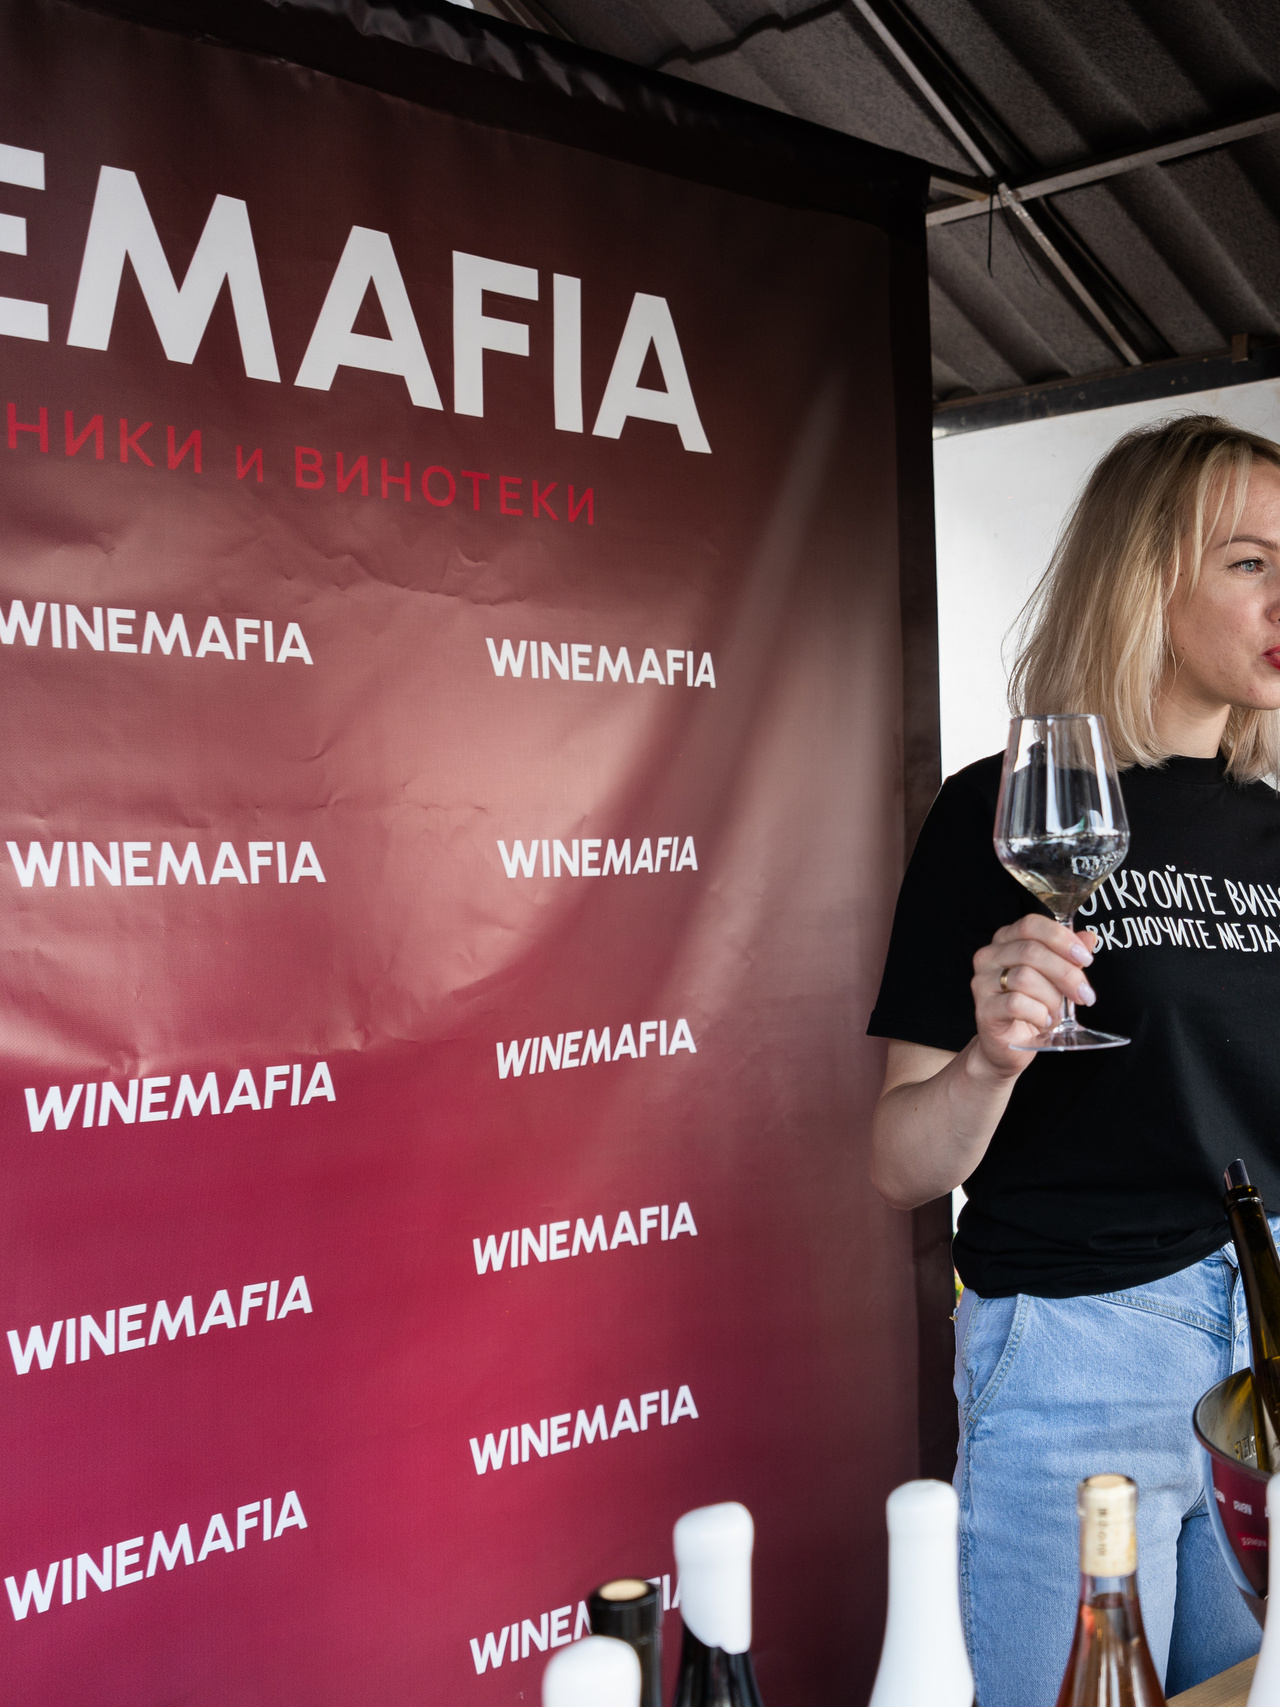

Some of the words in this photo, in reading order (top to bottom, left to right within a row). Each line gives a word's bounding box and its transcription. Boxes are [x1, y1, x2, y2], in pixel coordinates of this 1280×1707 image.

[0, 143, 712, 454] EMAFIA
[7, 402, 202, 474] НИКИ
[235, 445, 264, 483] и
[294, 446, 596, 525] ВИНОТЕКИ
[0, 600, 314, 665] WINEMAFIA
[486, 637, 716, 689] WINEMAFIA
[6, 841, 326, 887] WINEMAFIA
[497, 836, 698, 878] WINEMAFIA
[496, 1019, 697, 1079] WINEMAFIA
[24, 1061, 336, 1132] WINEMAFIA
[472, 1201, 698, 1275] WINEMAFIA
[6, 1275, 313, 1375] WINEMAFIA
[469, 1385, 698, 1475] WINEMAFIA
[4, 1490, 308, 1621] WINEMAFIA
[469, 1573, 680, 1675] WINEI
